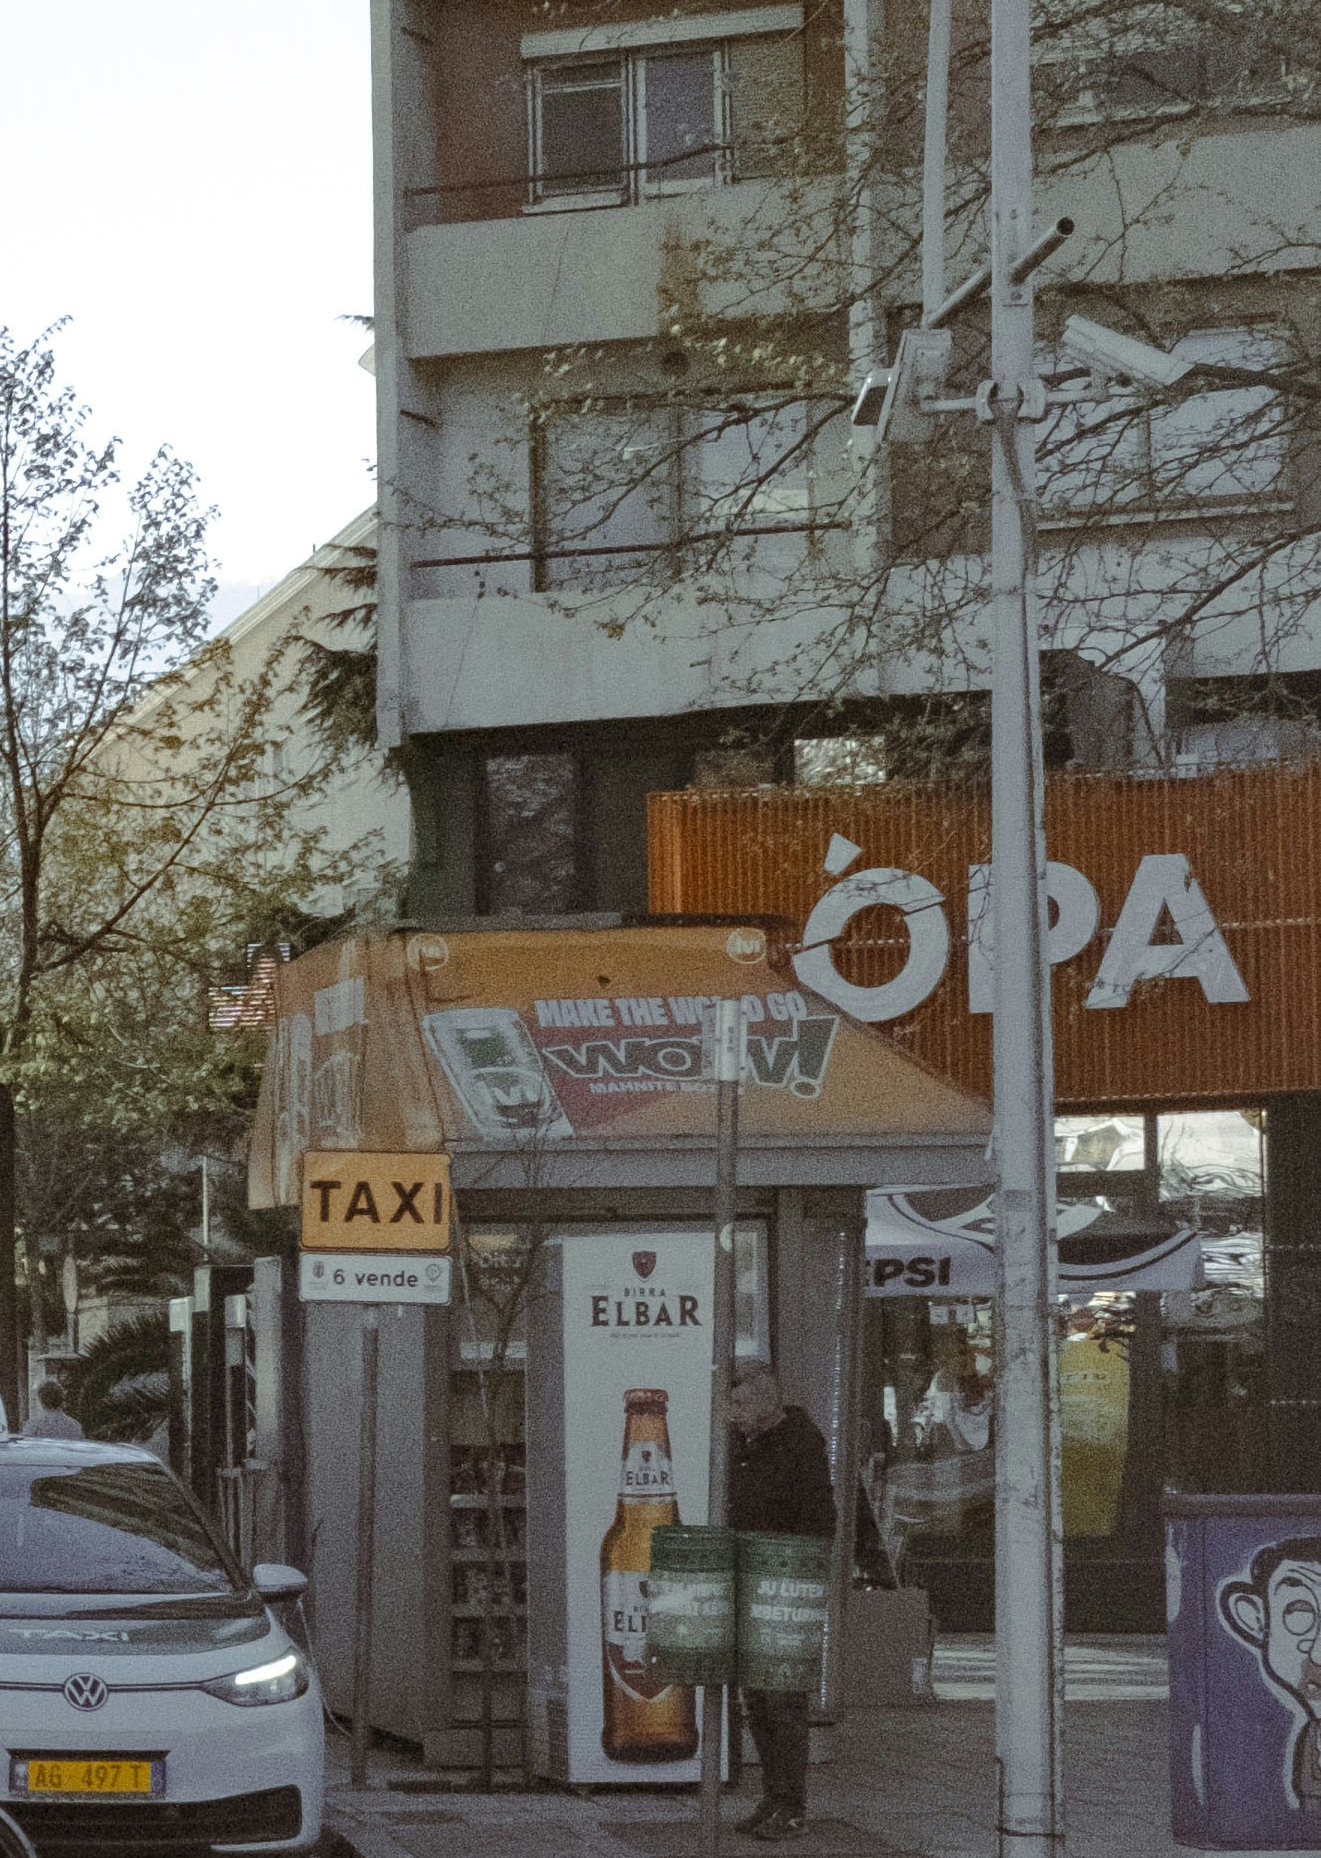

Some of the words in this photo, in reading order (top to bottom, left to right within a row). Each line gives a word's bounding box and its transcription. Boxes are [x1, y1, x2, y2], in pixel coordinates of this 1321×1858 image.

[534, 998, 615, 1029] MAKE
[616, 996, 666, 1026] THE
[668, 994, 765, 1025] WOD
[767, 990, 808, 1022] GO
[310, 1180, 444, 1225] TAXI
[333, 1268, 346, 1286] 6
[355, 1270, 419, 1288] vende
[863, 1256, 953, 1289] PSI
[591, 1295, 703, 1327] ELBAR
[625, 1470, 671, 1487] ELBAR
[9, 1628, 130, 1642] TAXI
